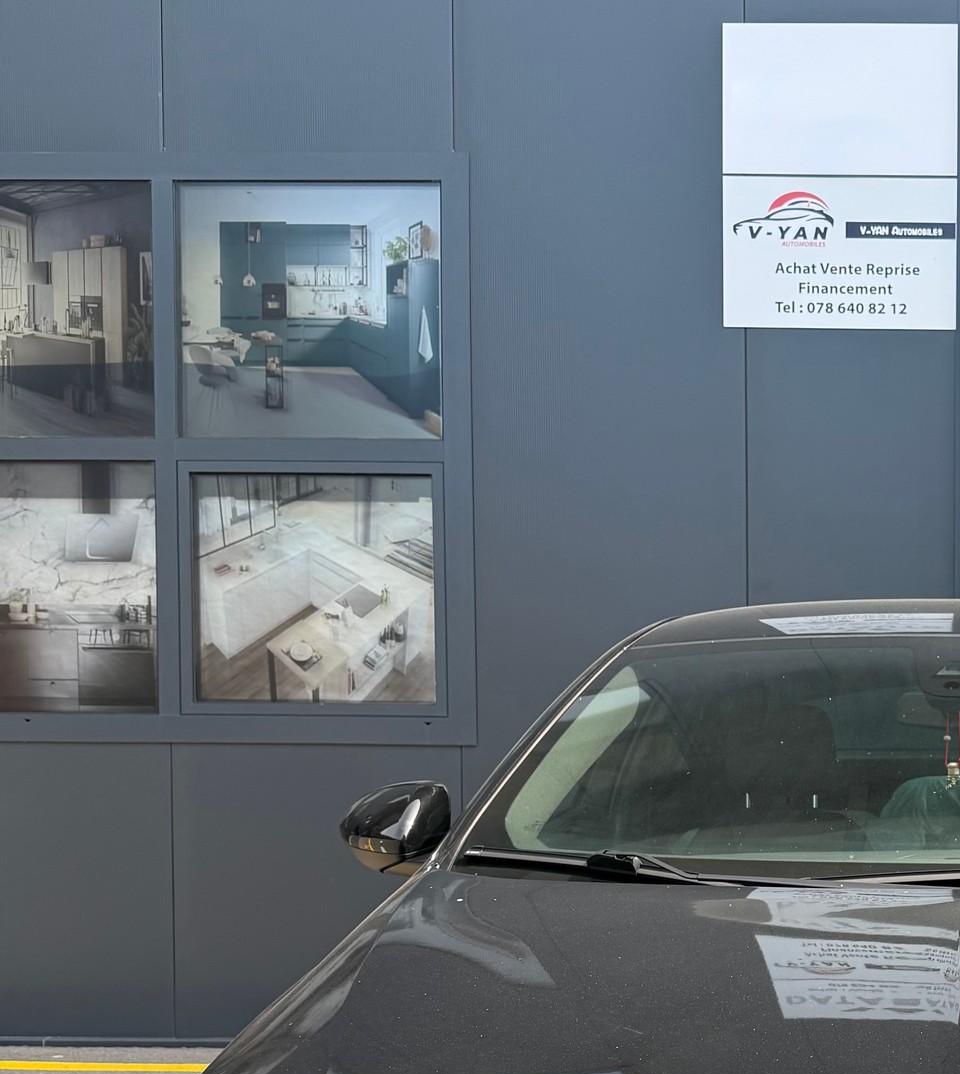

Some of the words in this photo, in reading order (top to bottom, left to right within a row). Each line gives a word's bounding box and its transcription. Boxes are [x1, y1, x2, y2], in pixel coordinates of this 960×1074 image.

[748, 225, 828, 240] V-YAN
[860, 226, 888, 236] V-YAN
[775, 262, 817, 275] Achat
[820, 263, 862, 276] Vente
[866, 263, 920, 278] Reprise
[798, 282, 893, 295] Financement
[807, 302, 834, 314] 078
[837, 303, 864, 314] 640
[868, 303, 886, 315] 82
[891, 303, 907, 315] 12
